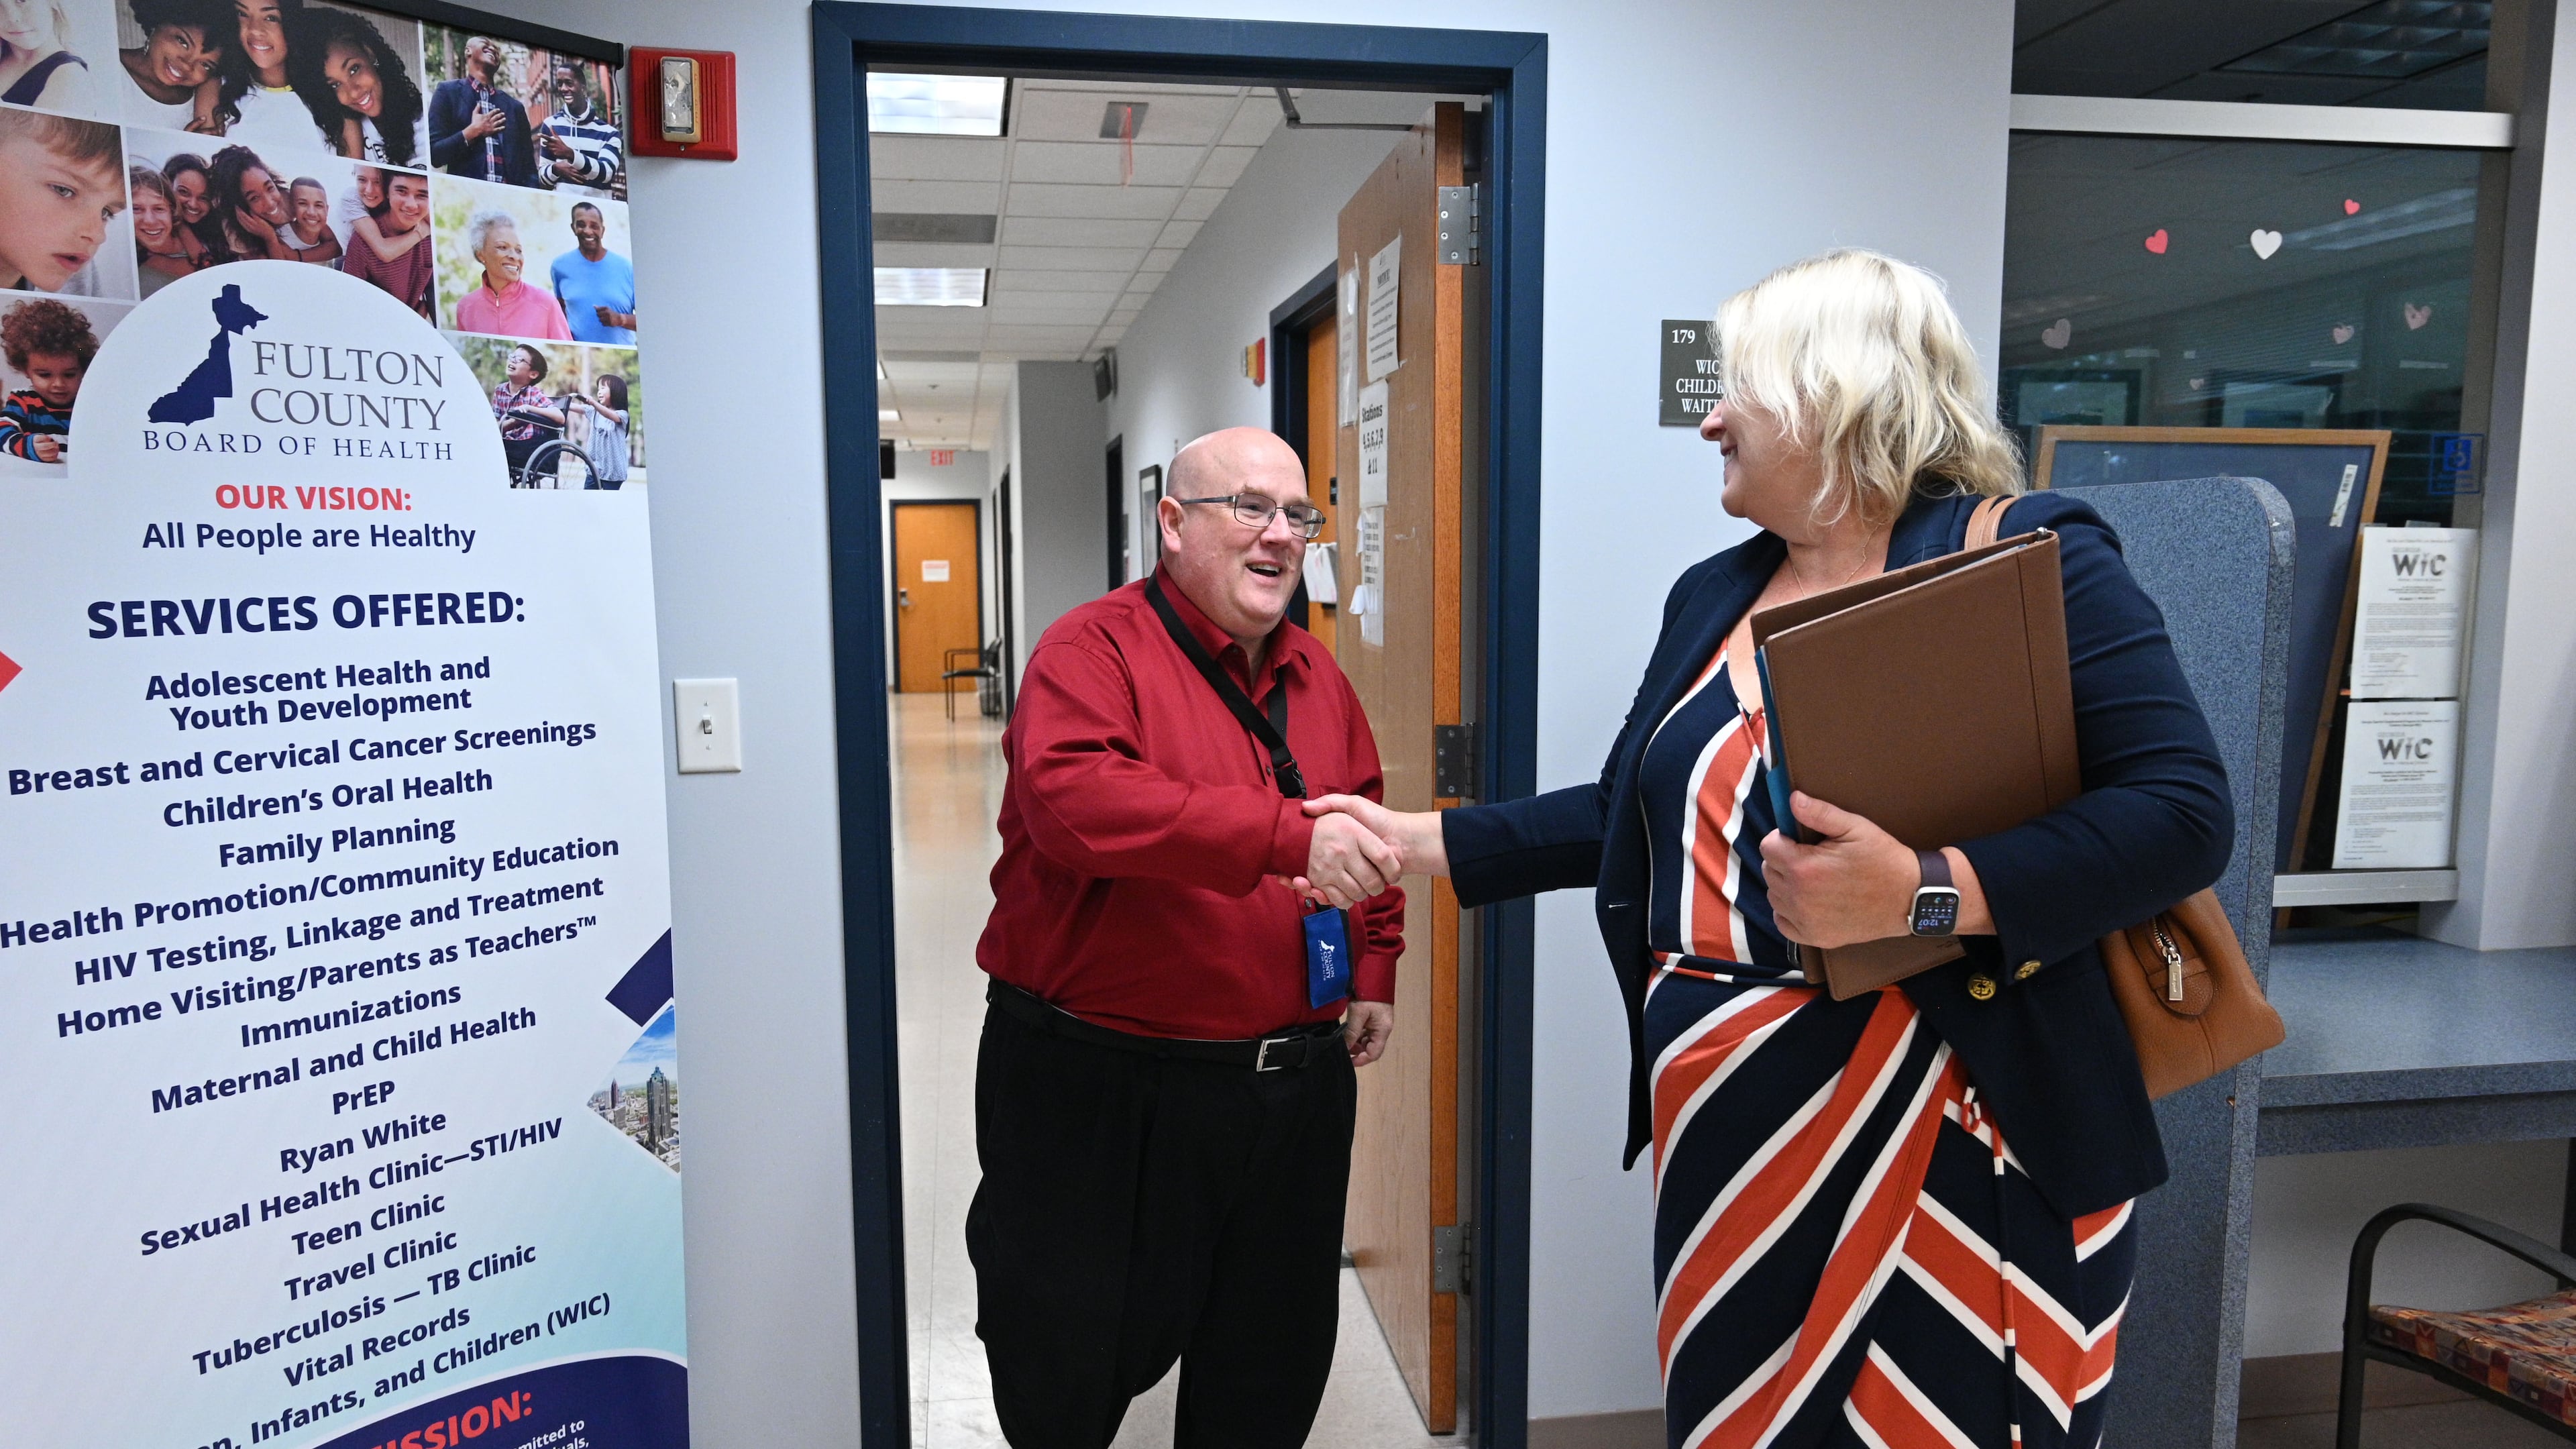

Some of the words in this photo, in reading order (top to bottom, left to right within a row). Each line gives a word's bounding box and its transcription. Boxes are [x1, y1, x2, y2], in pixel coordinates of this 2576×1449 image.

[1672, 329, 1696, 344] 179
[252, 341, 443, 388] FULTON
[1676, 378, 1725, 394] CHILDR
[1696, 359, 1720, 374] WIC
[251, 388, 445, 431] COUNTY
[1362, 404, 1383, 423] Stations
[142, 430, 262, 453] BOARD
[278, 436, 316, 455] OF
[333, 438, 452, 460] HEALTH
[931, 450, 954, 466] EXIT
[215, 484, 288, 509] OUR
[294, 486, 411, 511] VISION:
[142, 522, 184, 548] All
[196, 522, 302, 555] People
[312, 529, 360, 547] are
[370, 523, 476, 553] Healthy
[87, 596, 318, 639] SERVICES
[333, 591, 525, 629] OFFERED:
[145, 667, 327, 701] Adolescent
[335, 659, 431, 688] Health
[440, 655, 490, 681] and
[169, 700, 268, 731] Youth
[278, 688, 472, 723] Development
[8, 761, 130, 796] Breast
[140, 751, 203, 782] and
[213, 739, 340, 775] Cervical
[349, 735, 447, 761] Cancer
[454, 720, 596, 751] Screenings
[164, 788, 323, 827] Children’s
[332, 778, 394, 808] Oral
[402, 768, 492, 800] Health
[219, 833, 323, 868] Family
[332, 818, 456, 853] Planning
[0, 906, 123, 949] Health
[134, 855, 485, 928] Promotion/Community
[492, 837, 619, 872] Education
[74, 951, 138, 986] HIV
[146, 935, 276, 972] Testing,
[286, 913, 401, 949] Linkage
[410, 897, 460, 927] and
[467, 877, 604, 916] Treatment
[1323, 951, 1331, 979] COUNTY
[57, 1001, 162, 1038] Home
[170, 952, 421, 1015] Visiting/Parents
[429, 945, 458, 966] as
[241, 986, 462, 1048] Immunizations
[152, 1057, 300, 1114] Maternal
[309, 1042, 364, 1077] and
[372, 1026, 442, 1061] Child
[450, 1007, 536, 1044] Health
[332, 1080, 395, 1116] PrEP
[280, 1138, 354, 1174] Ryan
[362, 1114, 446, 1149] White
[140, 1203, 250, 1256] Sexual
[260, 1175, 360, 1222] Health
[291, 1221, 362, 1255] Teen
[370, 1193, 445, 1231] Clinic
[284, 1252, 375, 1301] Travel
[384, 1231, 457, 1269] Clinic
[192, 1295, 386, 1375] Tuberculosis
[427, 1269, 460, 1295] TB
[468, 1245, 536, 1281] Clinic
[251, 1390, 366, 1444] Infants,
[374, 1358, 425, 1398] and
[433, 1322, 541, 1374] Children
[547, 1292, 610, 1336] (WIC)
[283, 1343, 354, 1387] Vital
[362, 1307, 470, 1361] Records
[371, 1390, 533, 1449] SSION:
[570, 1420, 585, 1434] to
